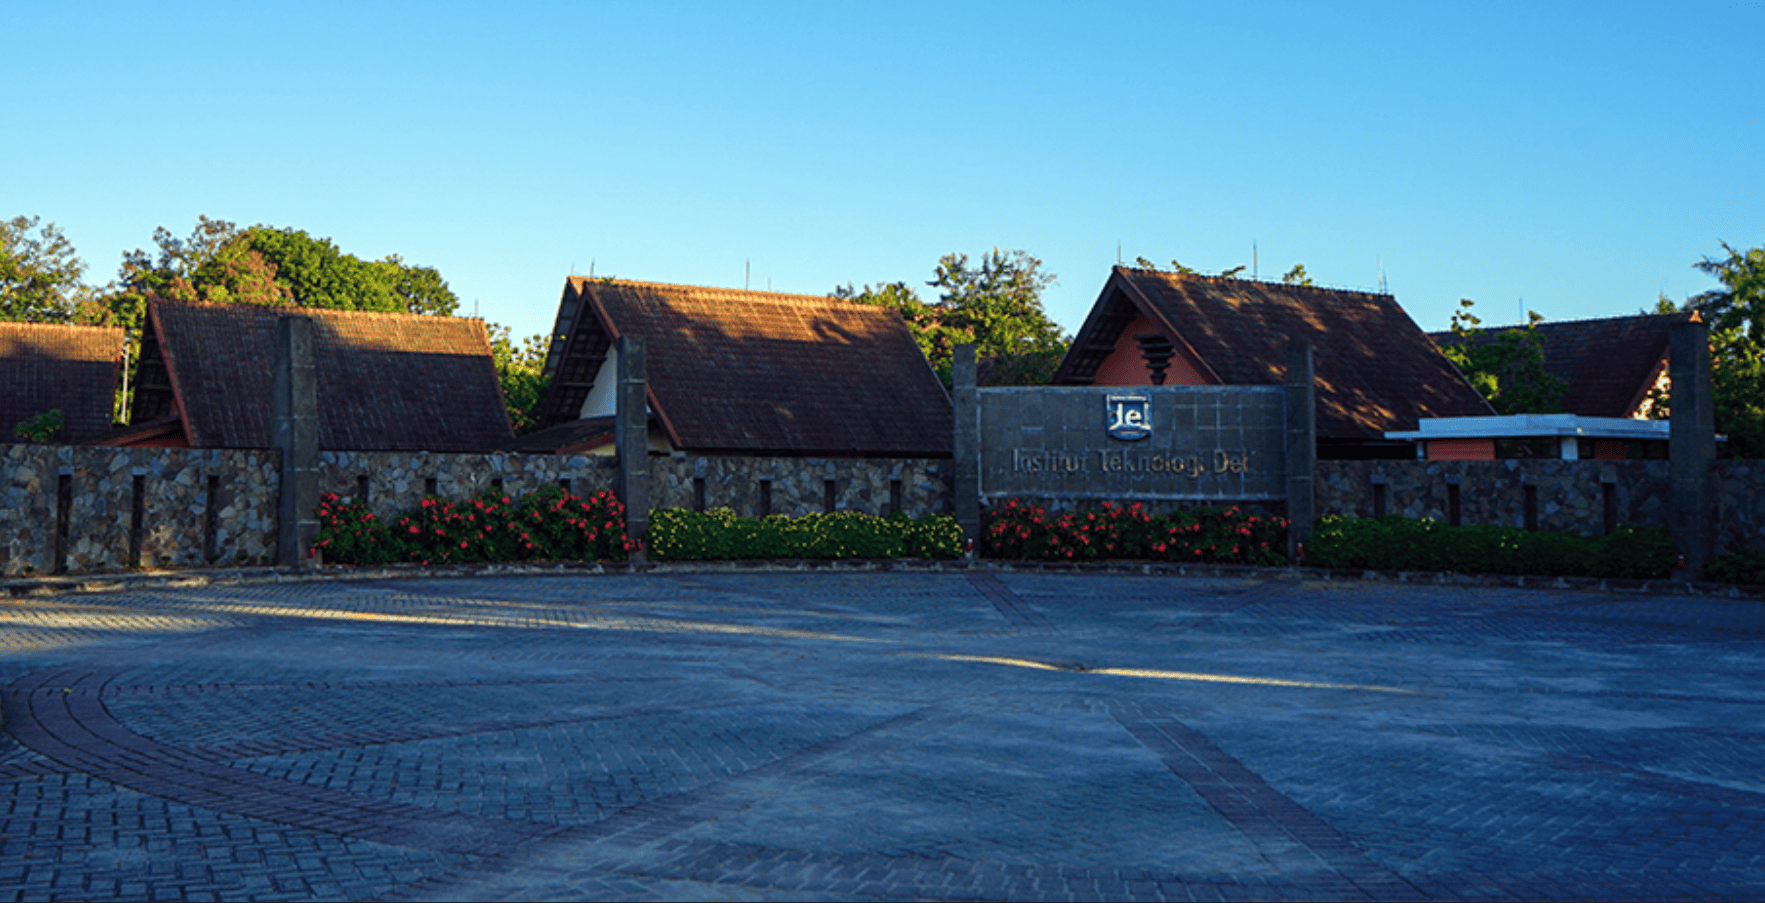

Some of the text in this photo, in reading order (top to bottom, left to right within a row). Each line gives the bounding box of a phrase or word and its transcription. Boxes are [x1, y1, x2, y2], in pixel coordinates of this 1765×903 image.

[1012, 448, 1248, 478] Institut Teknologi Del
